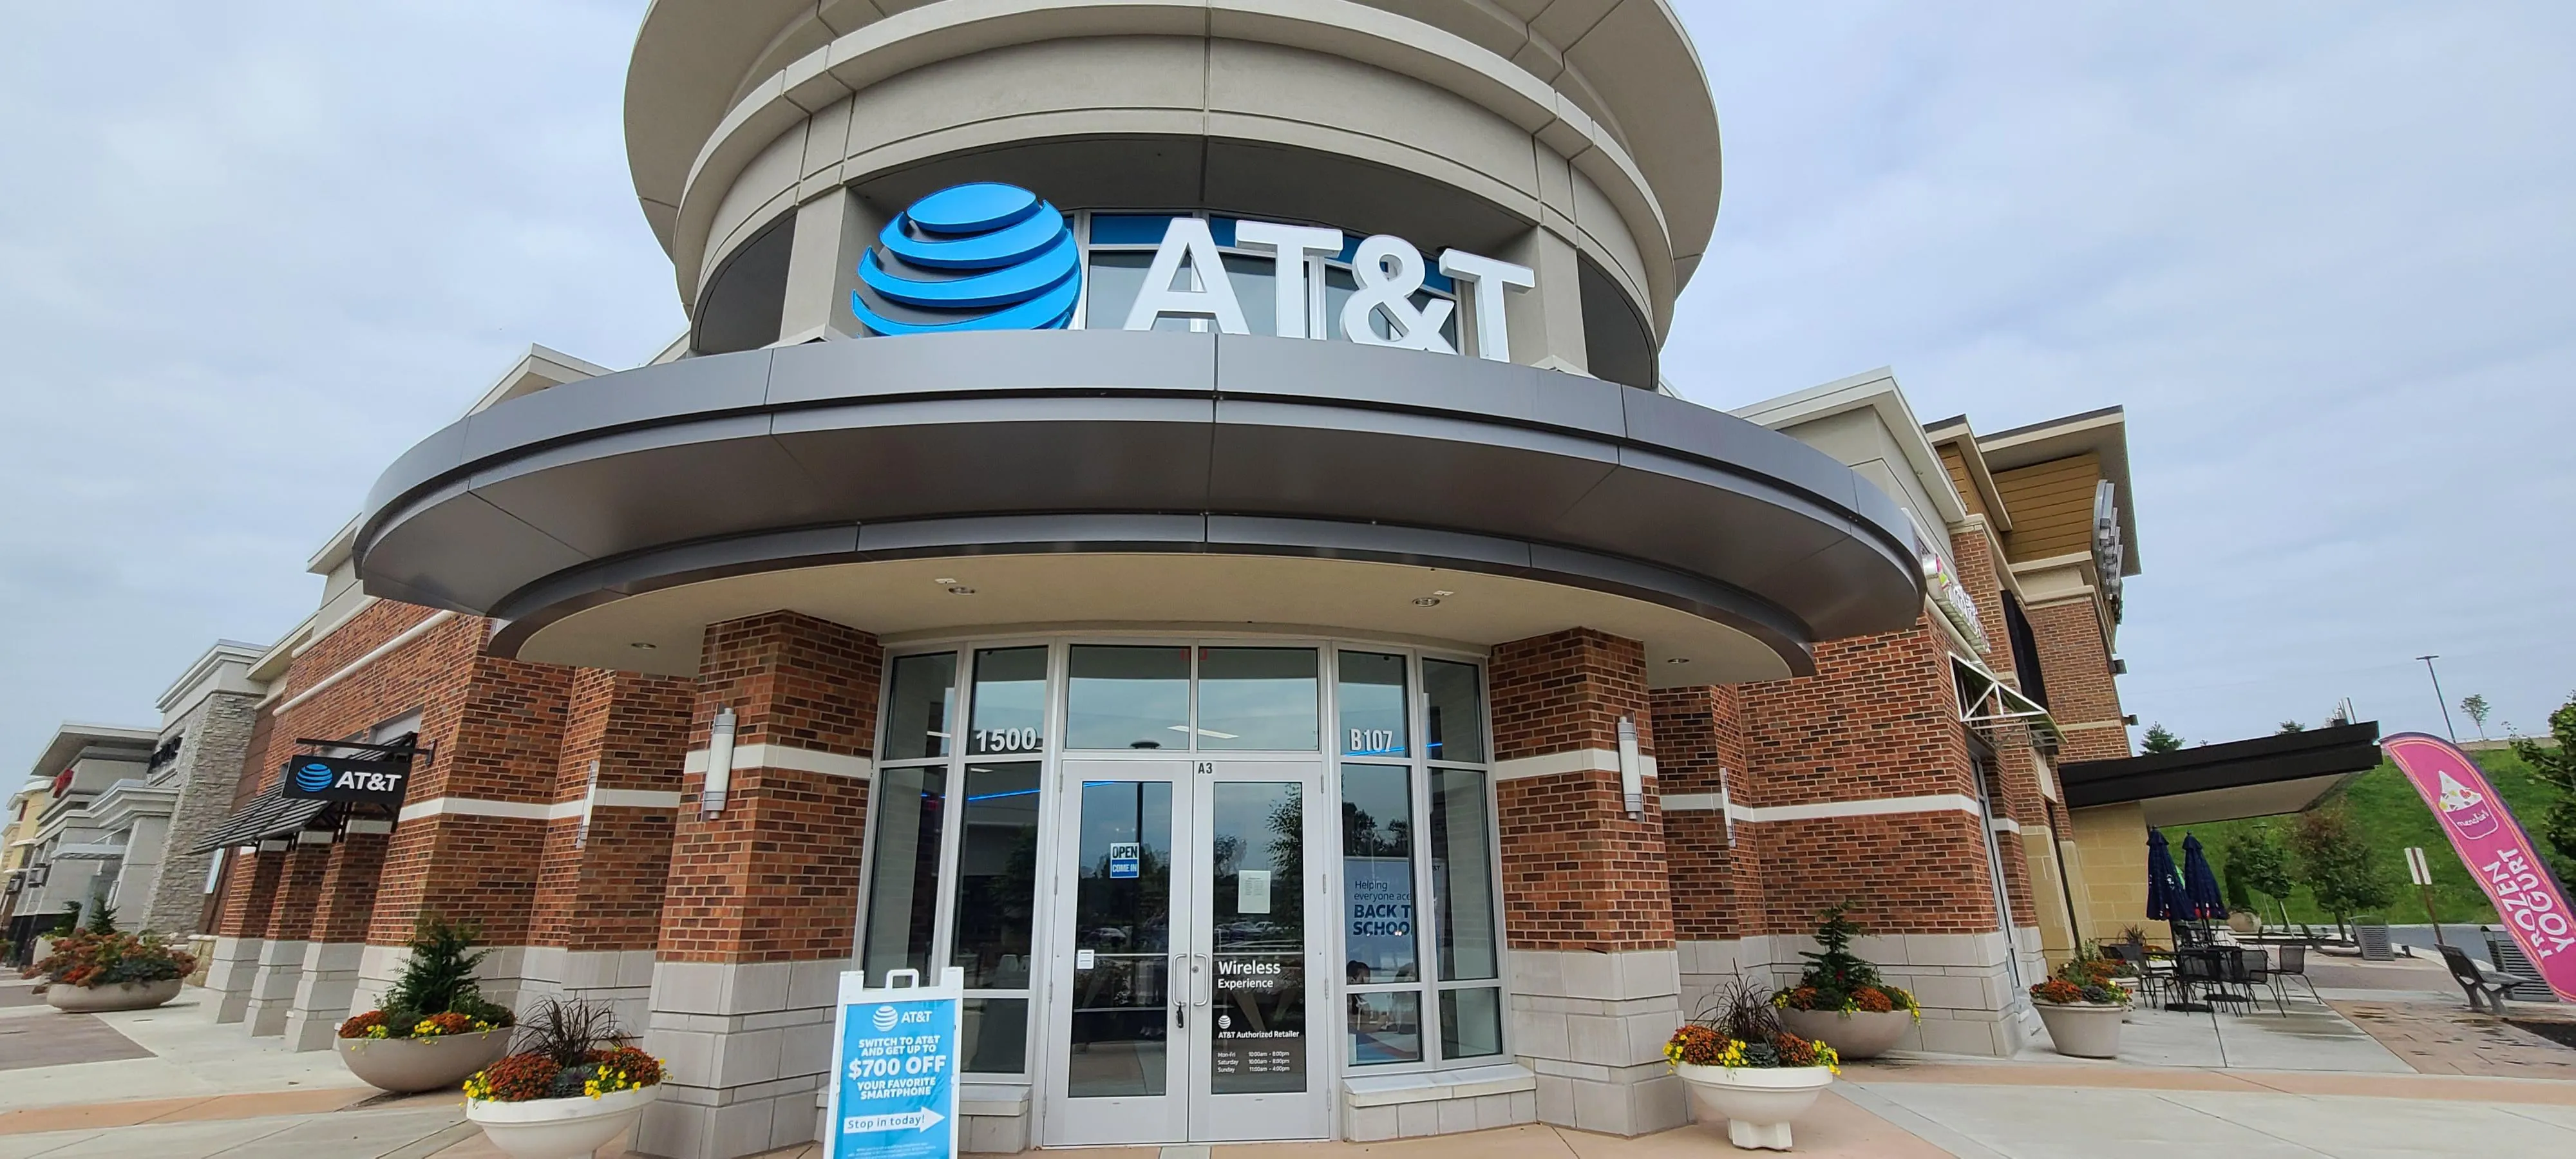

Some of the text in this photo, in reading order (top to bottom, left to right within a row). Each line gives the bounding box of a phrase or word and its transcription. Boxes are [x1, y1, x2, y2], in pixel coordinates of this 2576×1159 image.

[1123, 218, 1535, 363] AT&T
[976, 727, 1036, 751] 1500
[1350, 728, 1392, 752] B107
[1198, 762, 1213, 774] A3
[334, 771, 402, 791] AT&T
[1112, 846, 1137, 858] OPEN
[1355, 880, 1387, 891] Helping
[1354, 892, 1394, 903] everyone
[2496, 848, 2575, 953] YOGURT
[1354, 904, 1411, 919] BACK T
[1353, 921, 1412, 936] SCHOO
[1218, 960, 1281, 975] Wireless
[1218, 978, 1273, 990] Experience
[901, 1010, 933, 1023] AT&T
[858, 1035, 941, 1048] SWITCH TO AT&T
[861, 1044, 936, 1057] AND GET UP TO
[848, 1055, 947, 1080] $700 OFF
[857, 1077, 936, 1091] YOUR FAVORITE
[860, 1086, 932, 1100] SMARTPHONE
[848, 1115, 925, 1129] Stop in today!
